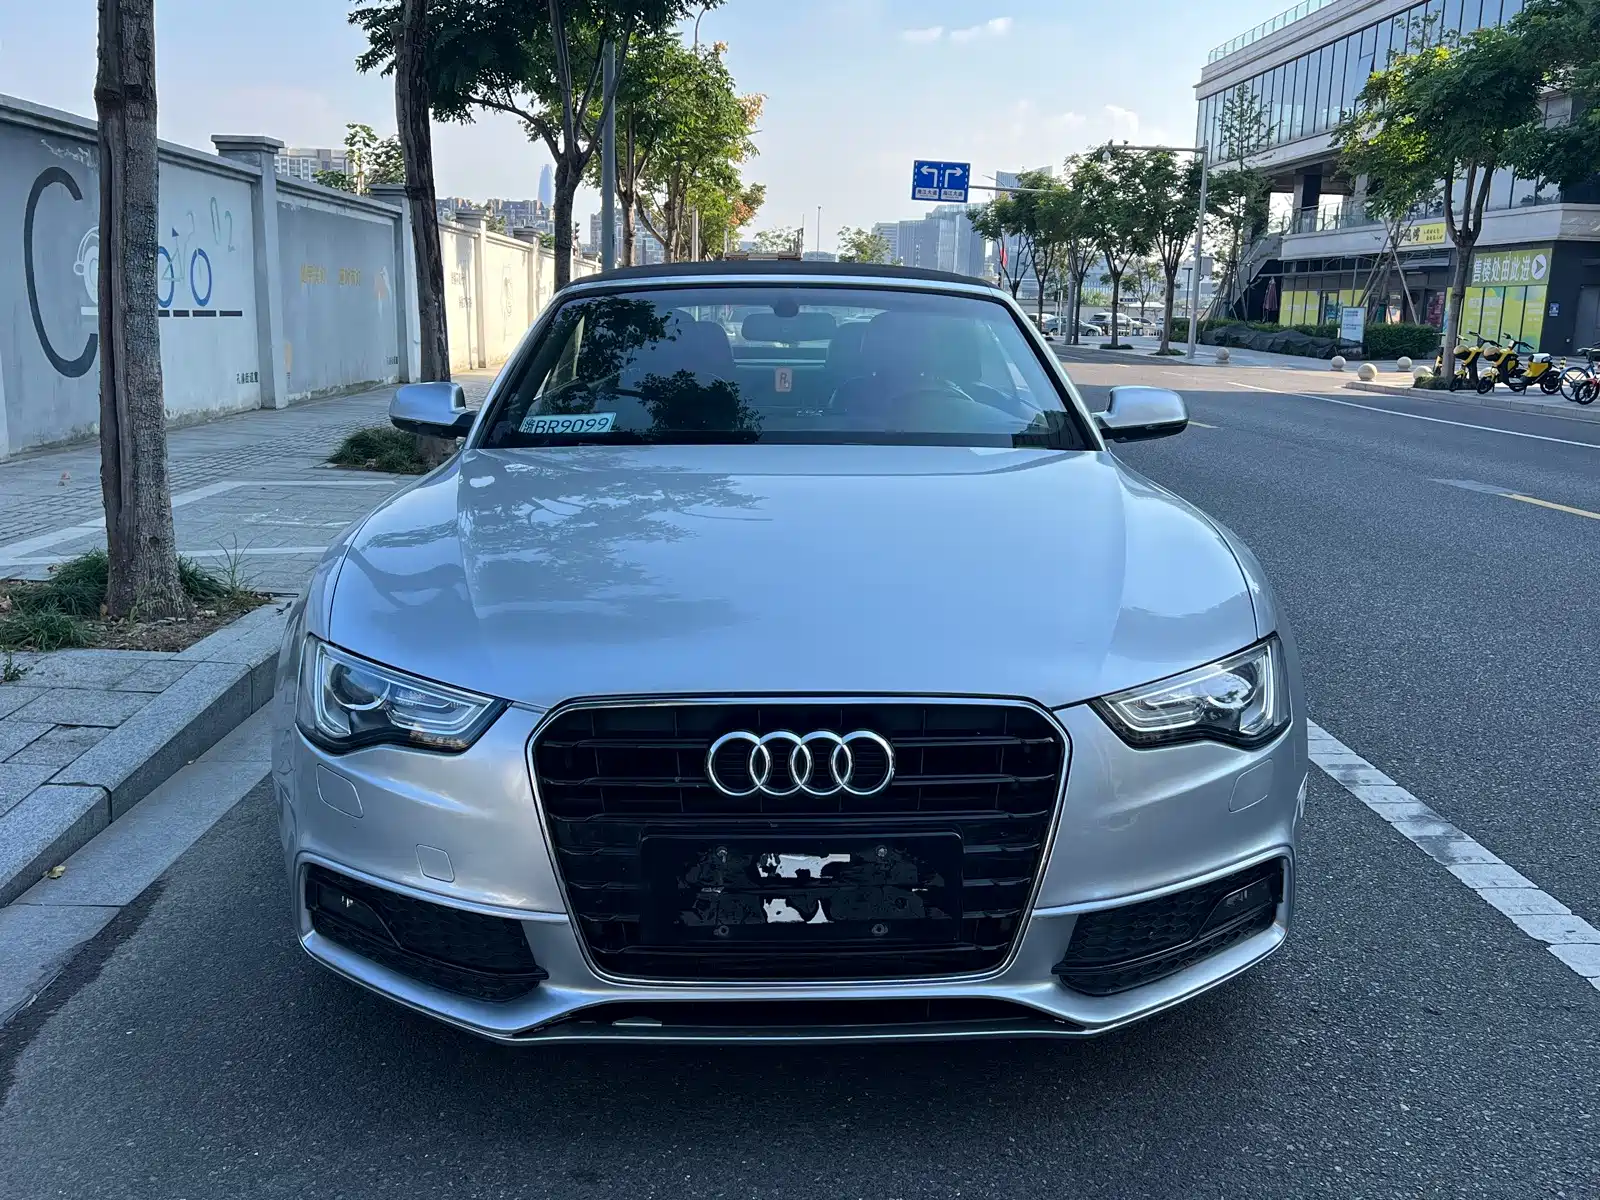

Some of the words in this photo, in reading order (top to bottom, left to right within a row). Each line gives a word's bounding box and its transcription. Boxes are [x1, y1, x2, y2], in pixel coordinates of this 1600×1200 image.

[1472, 254, 1531, 282] 售楼处由此进
